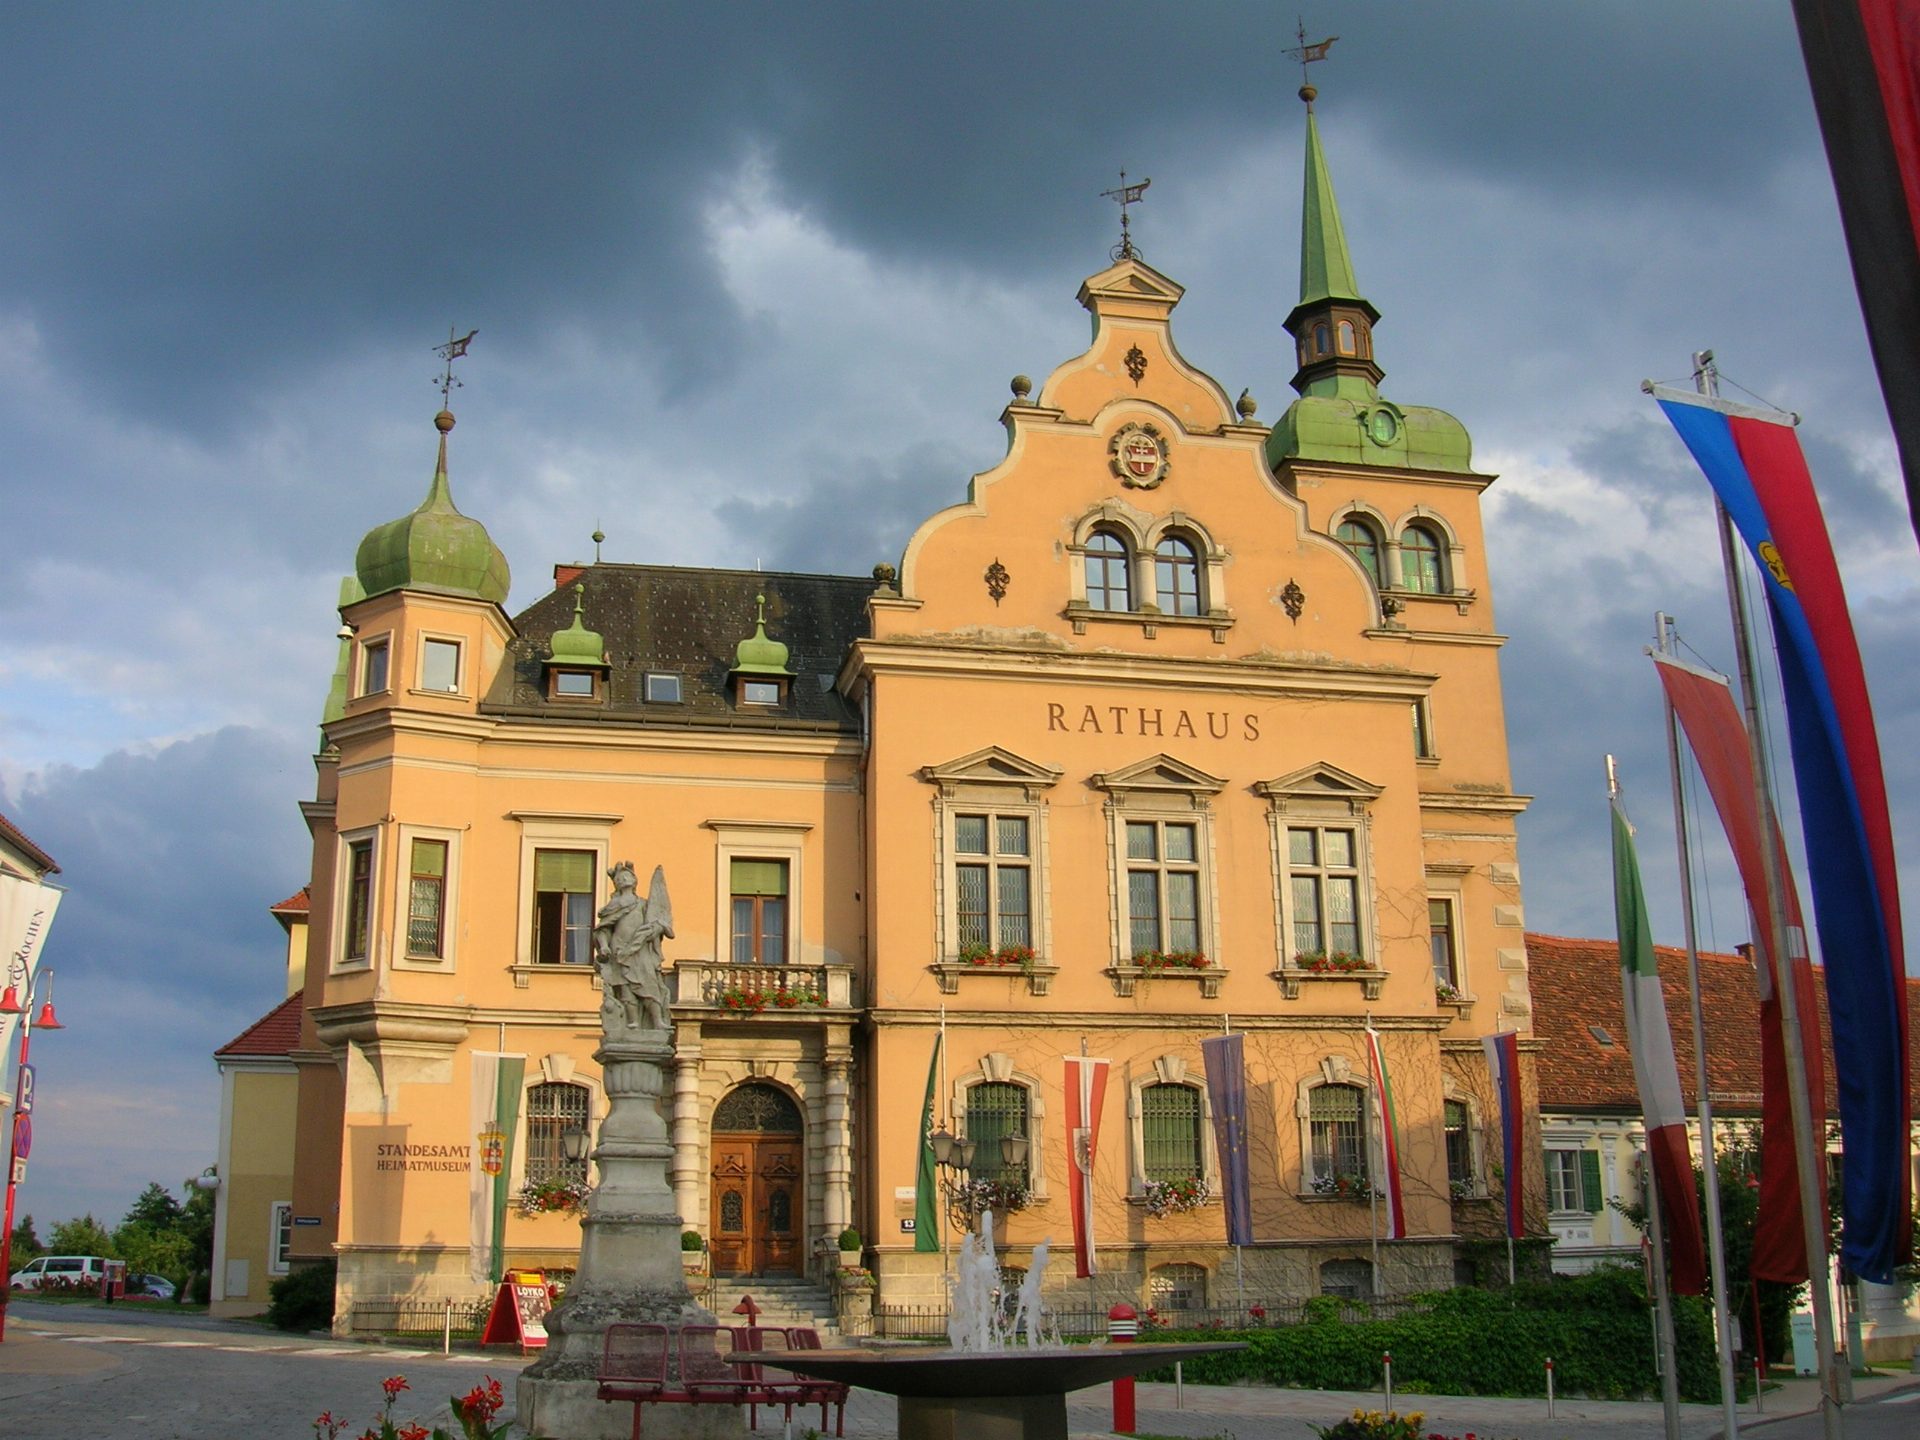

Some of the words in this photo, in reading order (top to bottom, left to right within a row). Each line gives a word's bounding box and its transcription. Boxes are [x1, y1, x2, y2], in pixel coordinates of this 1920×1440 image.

[1047, 702, 1260, 742] RATHAUS
[21, 1067, 33, 1111] P
[377, 1144, 471, 1158] STANDESAMT
[376, 1160, 471, 1173] HEIMATMUSEUM
[904, 1219, 914, 1228] 13
[516, 1286, 545, 1297] LOYKO
